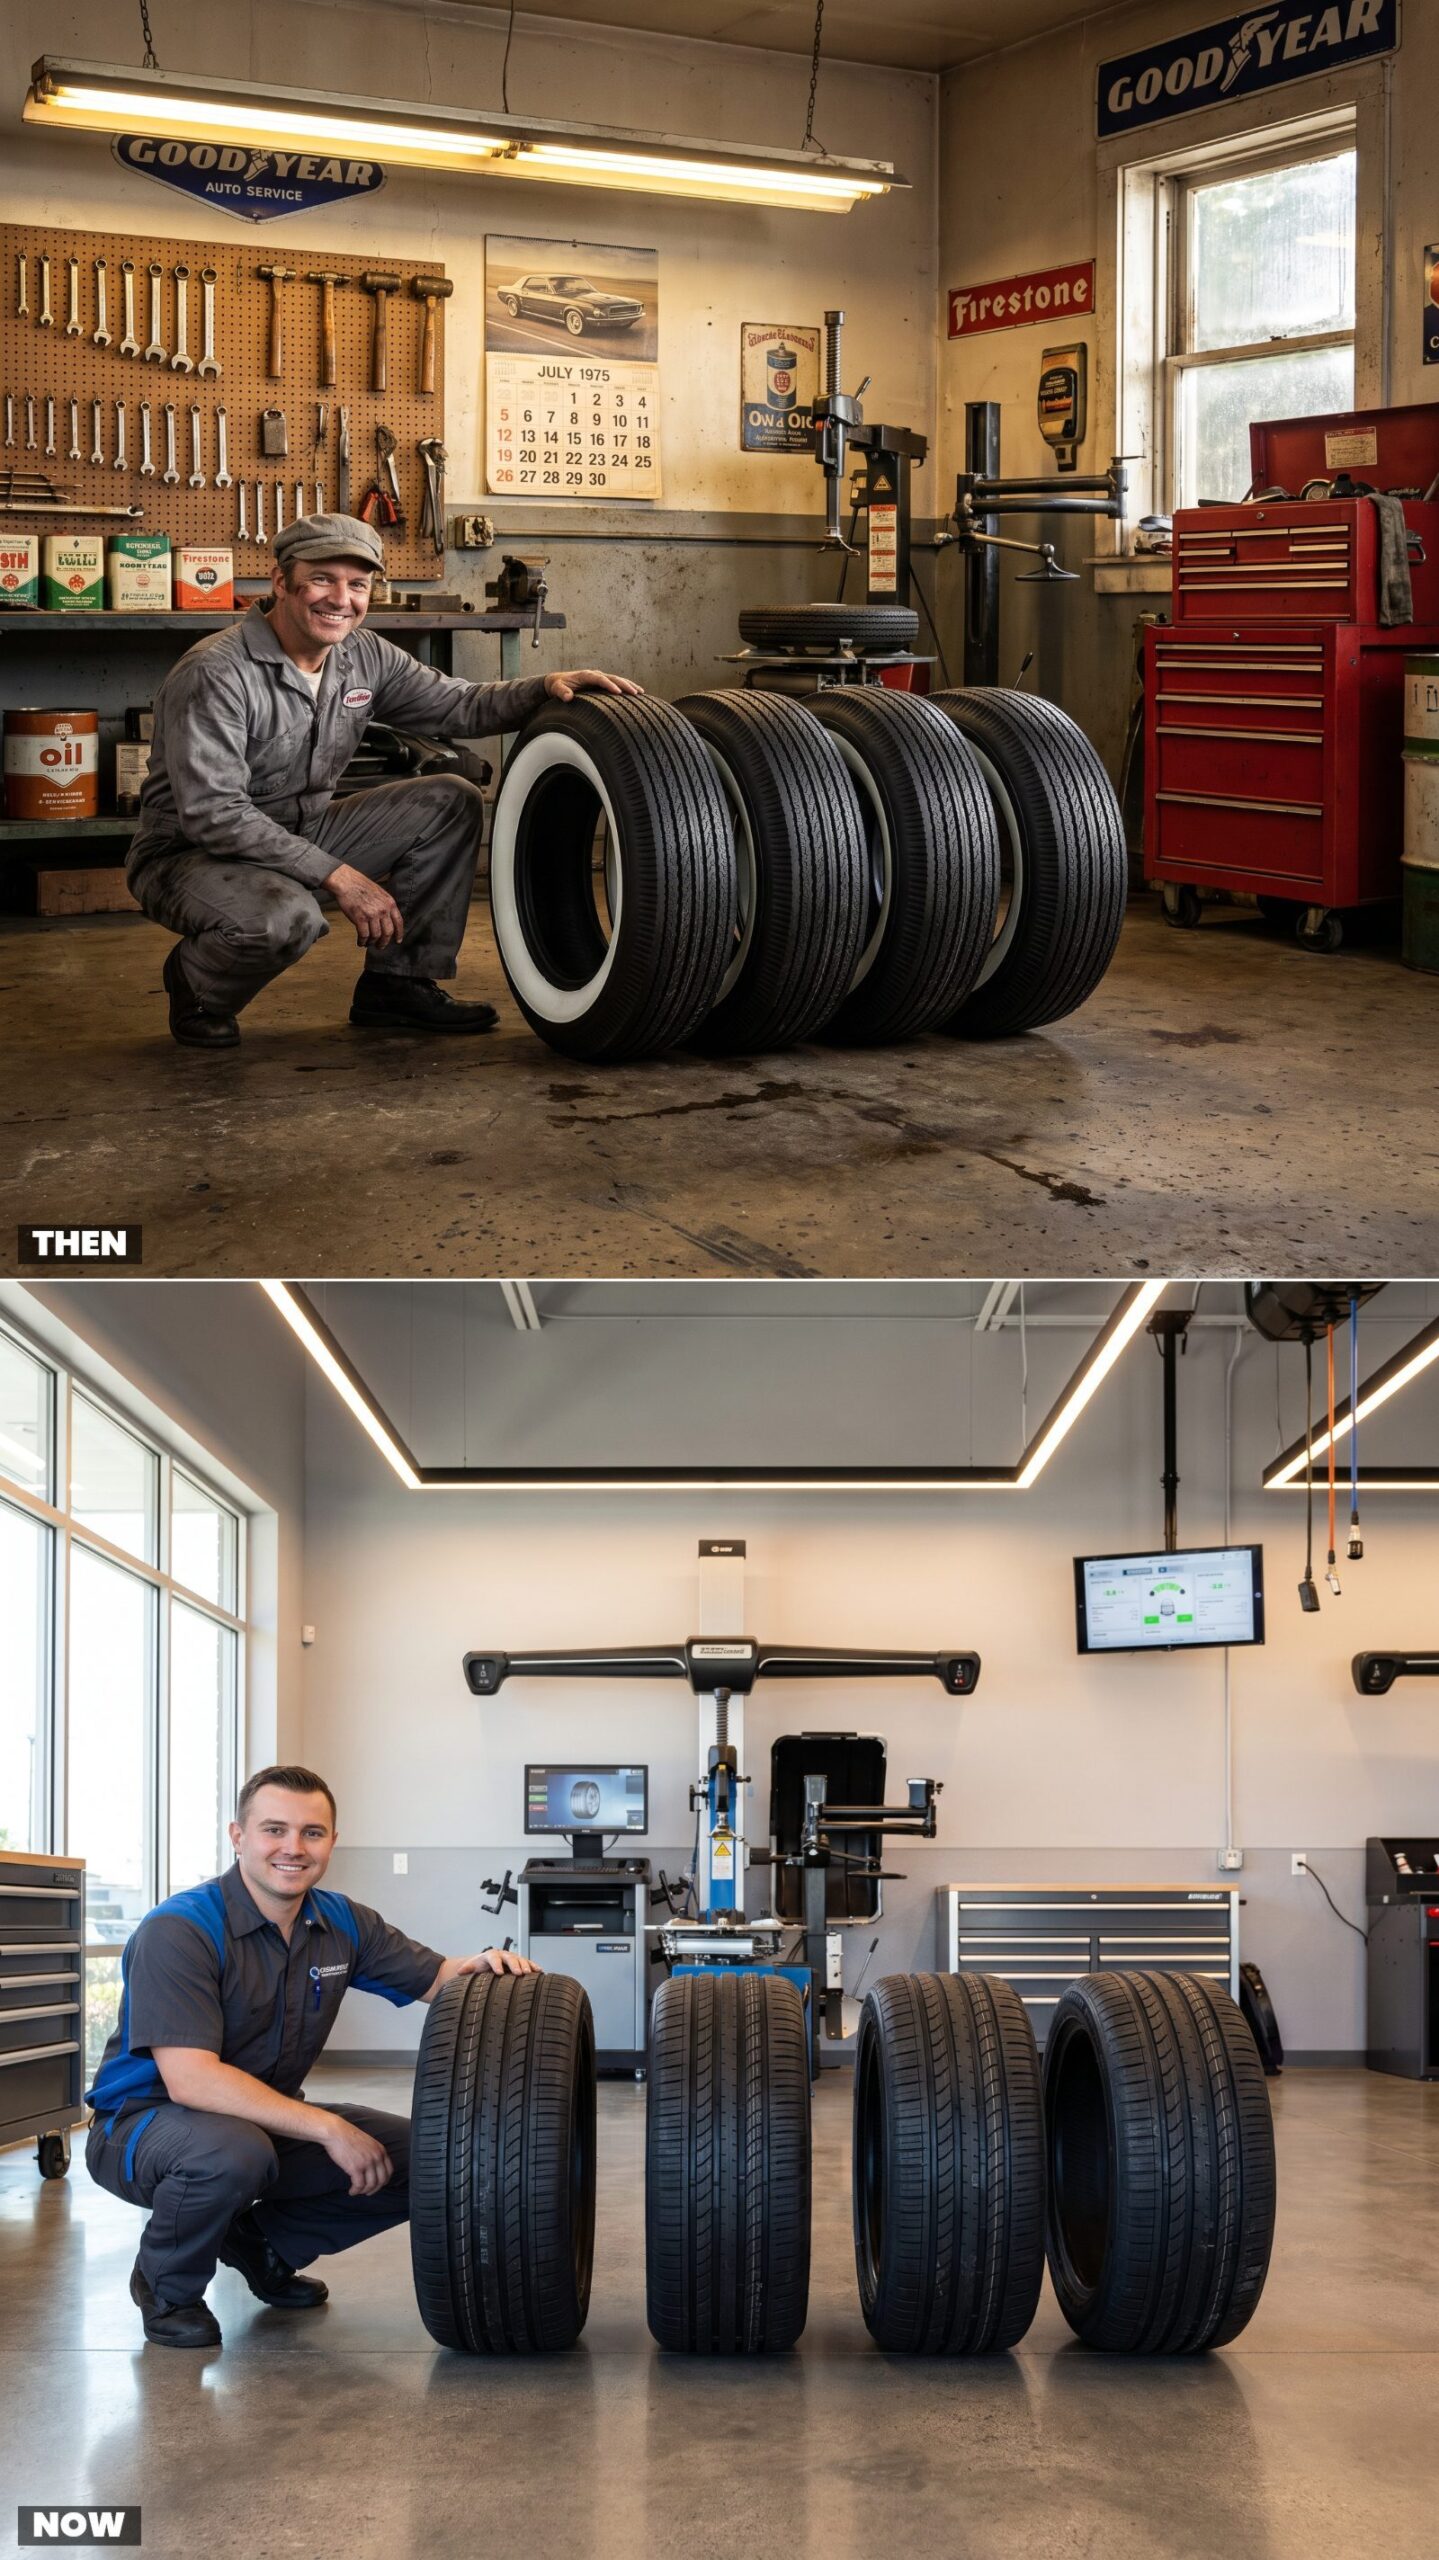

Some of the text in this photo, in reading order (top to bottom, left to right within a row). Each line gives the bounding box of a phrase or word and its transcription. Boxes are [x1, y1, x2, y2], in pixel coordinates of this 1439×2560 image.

[205, 181, 303, 201] AUTO SERVICE
[952, 278, 1088, 331] Firestone
[537, 365, 611, 381] JULY 1975
[570, 392, 577, 404] 1
[593, 393, 602, 406] 2
[615, 395, 624, 407] 3
[638, 396, 647, 408] 4
[500, 408, 649, 428] 5 6 7 8 9 10 11
[497, 429, 651, 448] 12 13 14 15 16 17 18
[497, 449, 652, 468] 19 20 21 22 23 24 25
[496, 469, 606, 486] 26 27 28 29 30
[40, 743, 82, 766] oil
